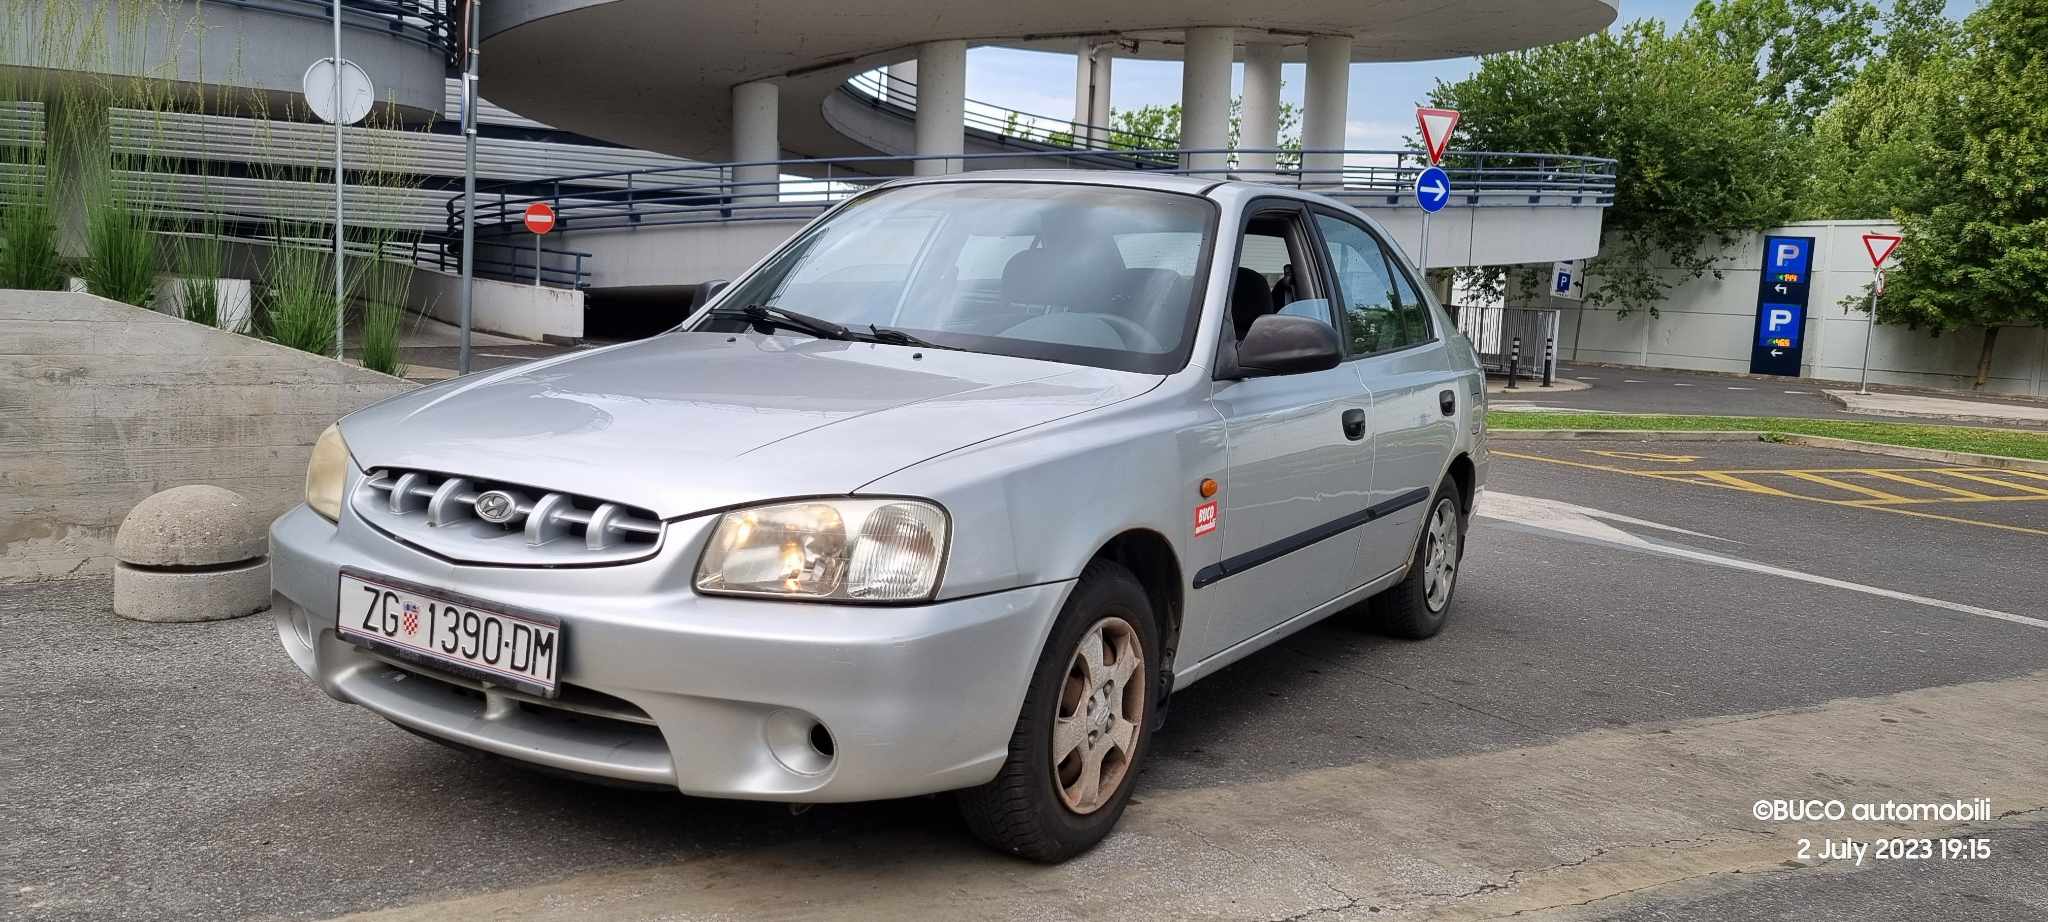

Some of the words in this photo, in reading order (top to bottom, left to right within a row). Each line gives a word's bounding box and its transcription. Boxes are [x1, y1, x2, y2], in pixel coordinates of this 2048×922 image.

[1777, 245, 1799, 266] P
[1561, 276, 1568, 288] P
[1769, 309, 1792, 331] P
[362, 586, 400, 637] ZG
